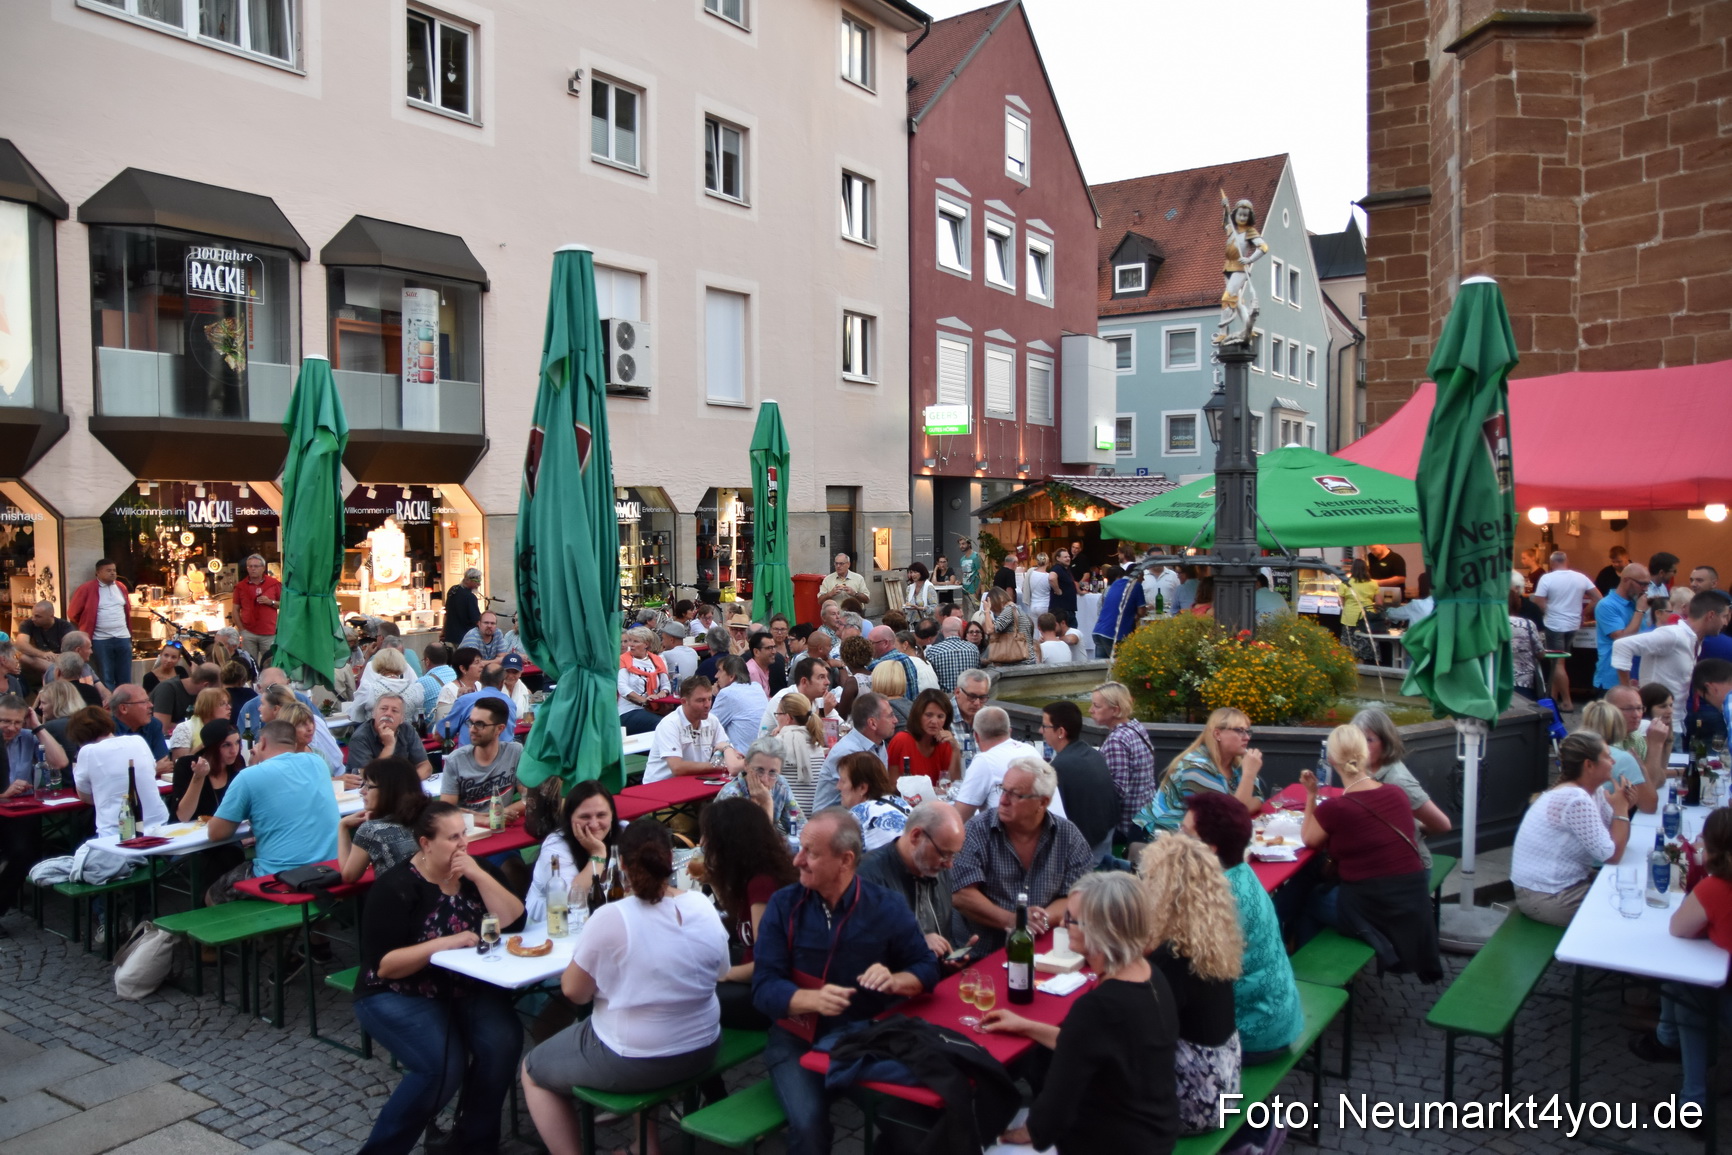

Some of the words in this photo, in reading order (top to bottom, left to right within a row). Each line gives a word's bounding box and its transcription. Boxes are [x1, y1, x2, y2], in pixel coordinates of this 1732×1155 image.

[197, 247, 217, 260] 100
[219, 249, 254, 262] Jahre
[191, 261, 245, 295] RACKL
[929, 411, 958, 420] GEERS
[115, 507, 173, 516] Willkommen
[174, 508, 186, 516] im
[188, 500, 234, 523] RACKL
[396, 500, 431, 520] RACKL
[1313, 498, 1400, 508] Neumarkter
